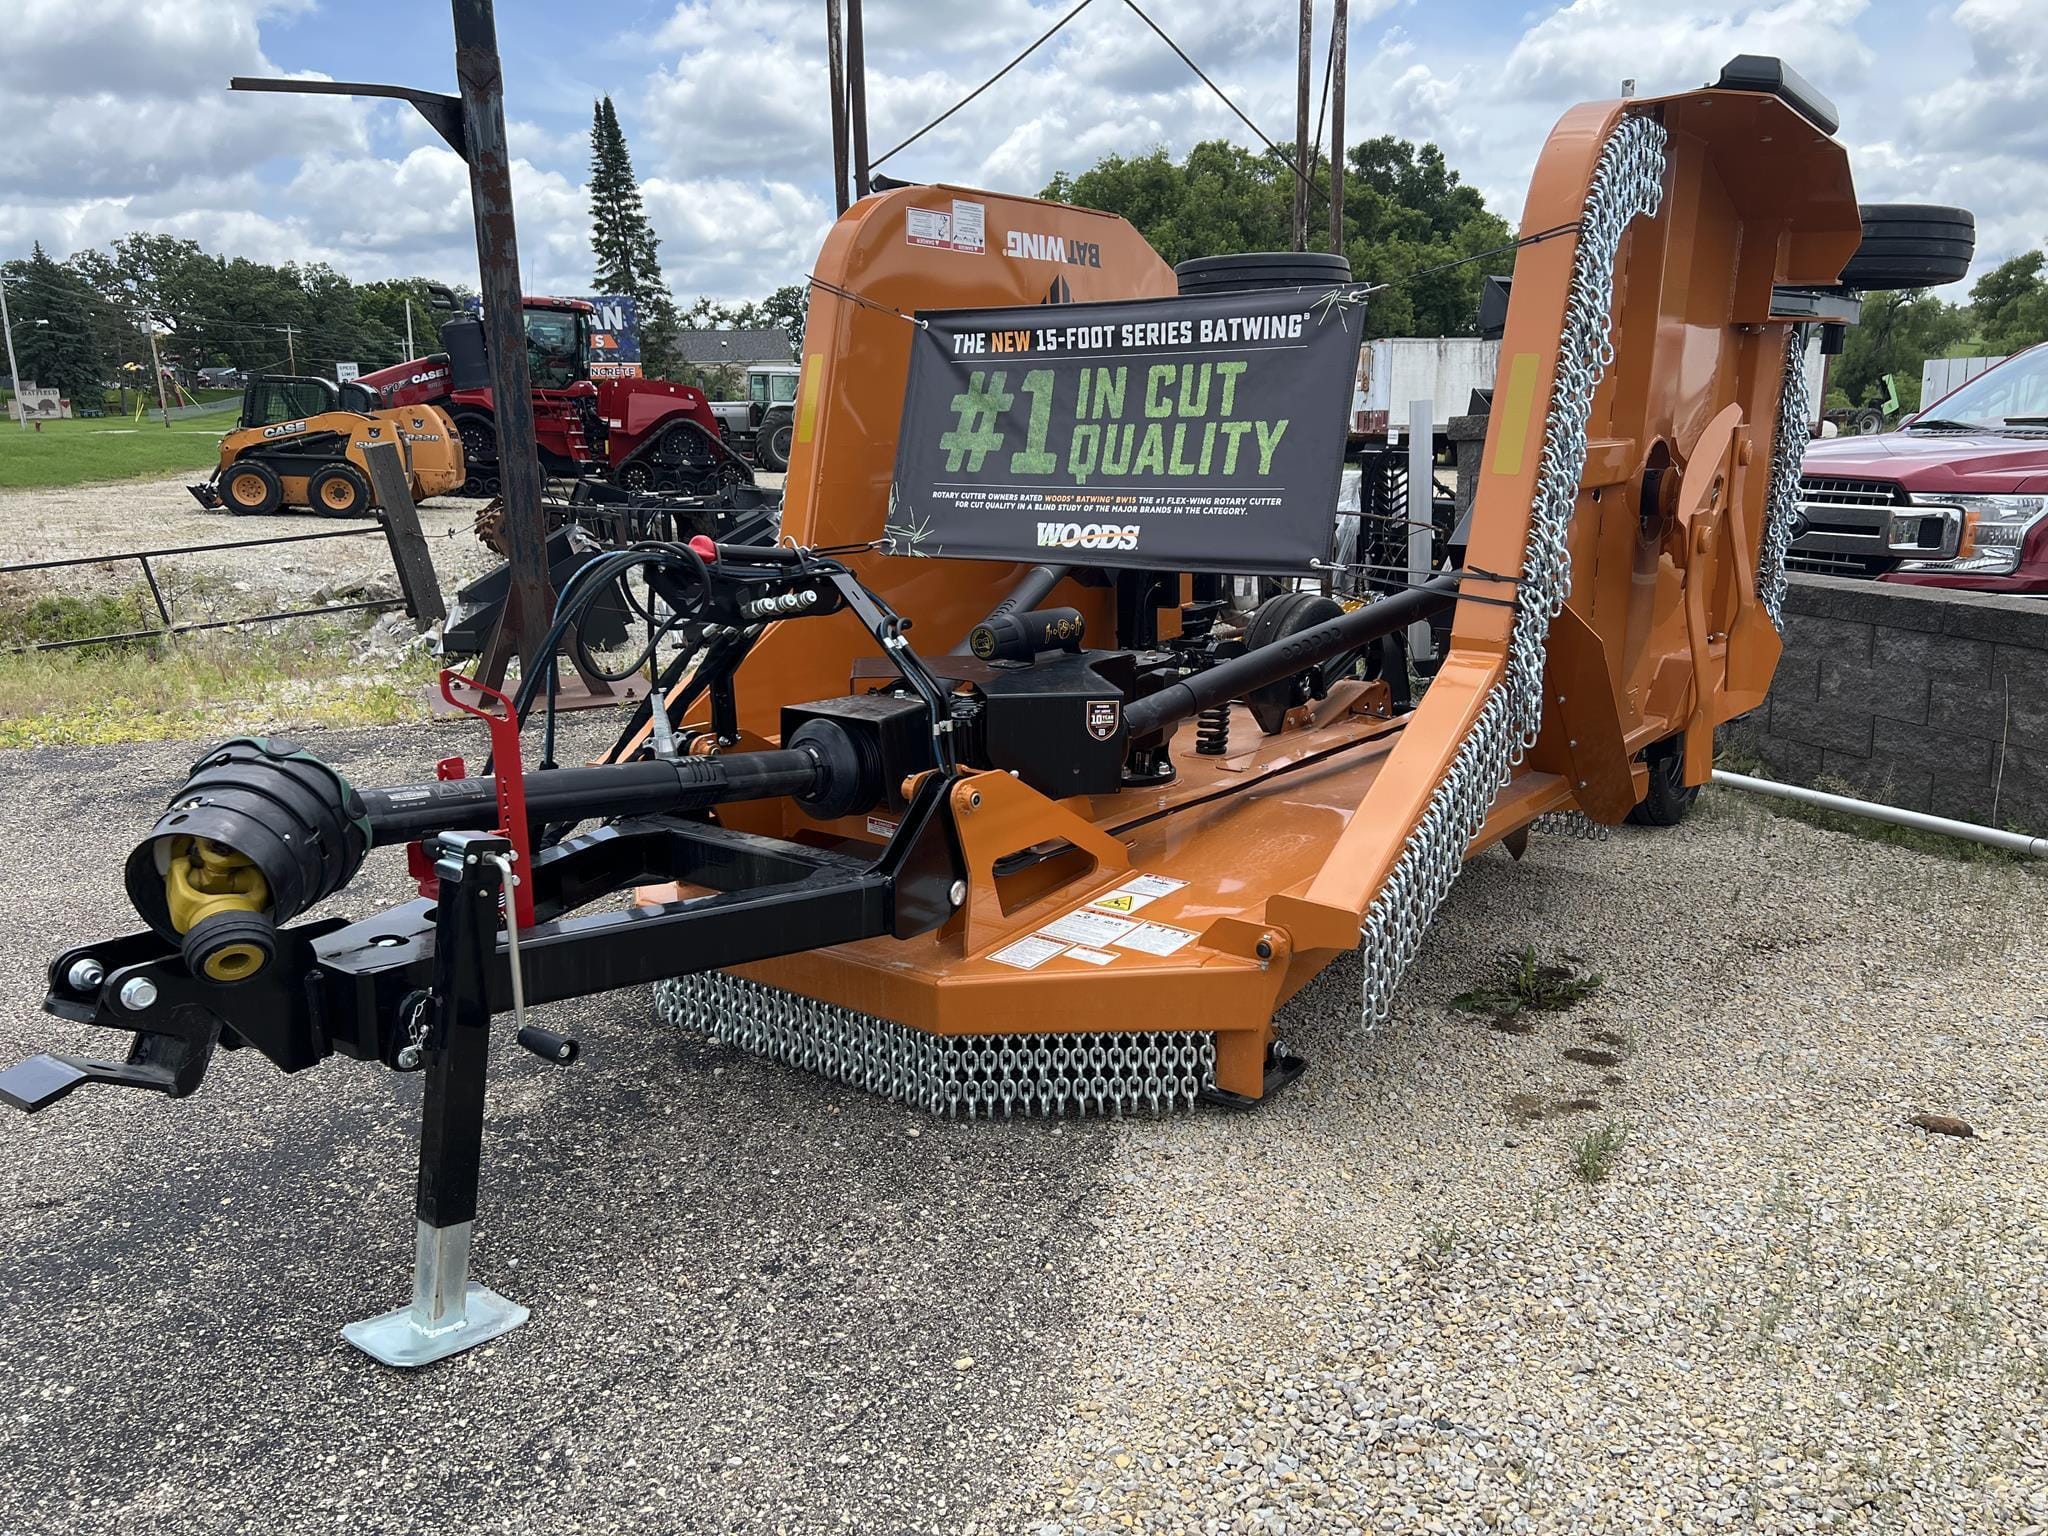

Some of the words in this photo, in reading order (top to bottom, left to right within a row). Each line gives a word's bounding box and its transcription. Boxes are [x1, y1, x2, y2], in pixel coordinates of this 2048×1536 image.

[953, 333, 986, 354] THE
[991, 330, 1031, 353] NEW
[1036, 325, 1116, 351] 15-FOOT
[1122, 321, 1192, 347] SERIES
[411, 369, 444, 384] CASE
[1075, 367, 1127, 419] IN
[1145, 361, 1248, 418] CUT
[263, 420, 307, 439] CASE
[939, 369, 1057, 473] #1
[1068, 419, 1289, 485] QUALITY
[932, 491, 960, 499] ROTARY
[960, 492, 986, 500] CUTTER
[988, 493, 1018, 501] OWNERS
[1019, 494, 1043, 502] RATED
[1116, 496, 1137, 504] BW15
[1139, 496, 1154, 504] THE
[1166, 497, 1212, 505] FLEX-WING
[1214, 497, 1247, 505] ROTARY
[1249, 497, 1282, 506] CUTTER
[985, 502, 1016, 510] QUALITY
[1034, 503, 1056, 511] BLIND
[1083, 504, 1094, 512] OF
[1111, 505, 1138, 513] MAJOR
[1140, 506, 1172, 514] BRANDS
[1173, 506, 1183, 514] IN
[1185, 506, 1201, 514] THE
[1202, 507, 1249, 515] CATEGORY.
[1091, 714, 1102, 725] 10
